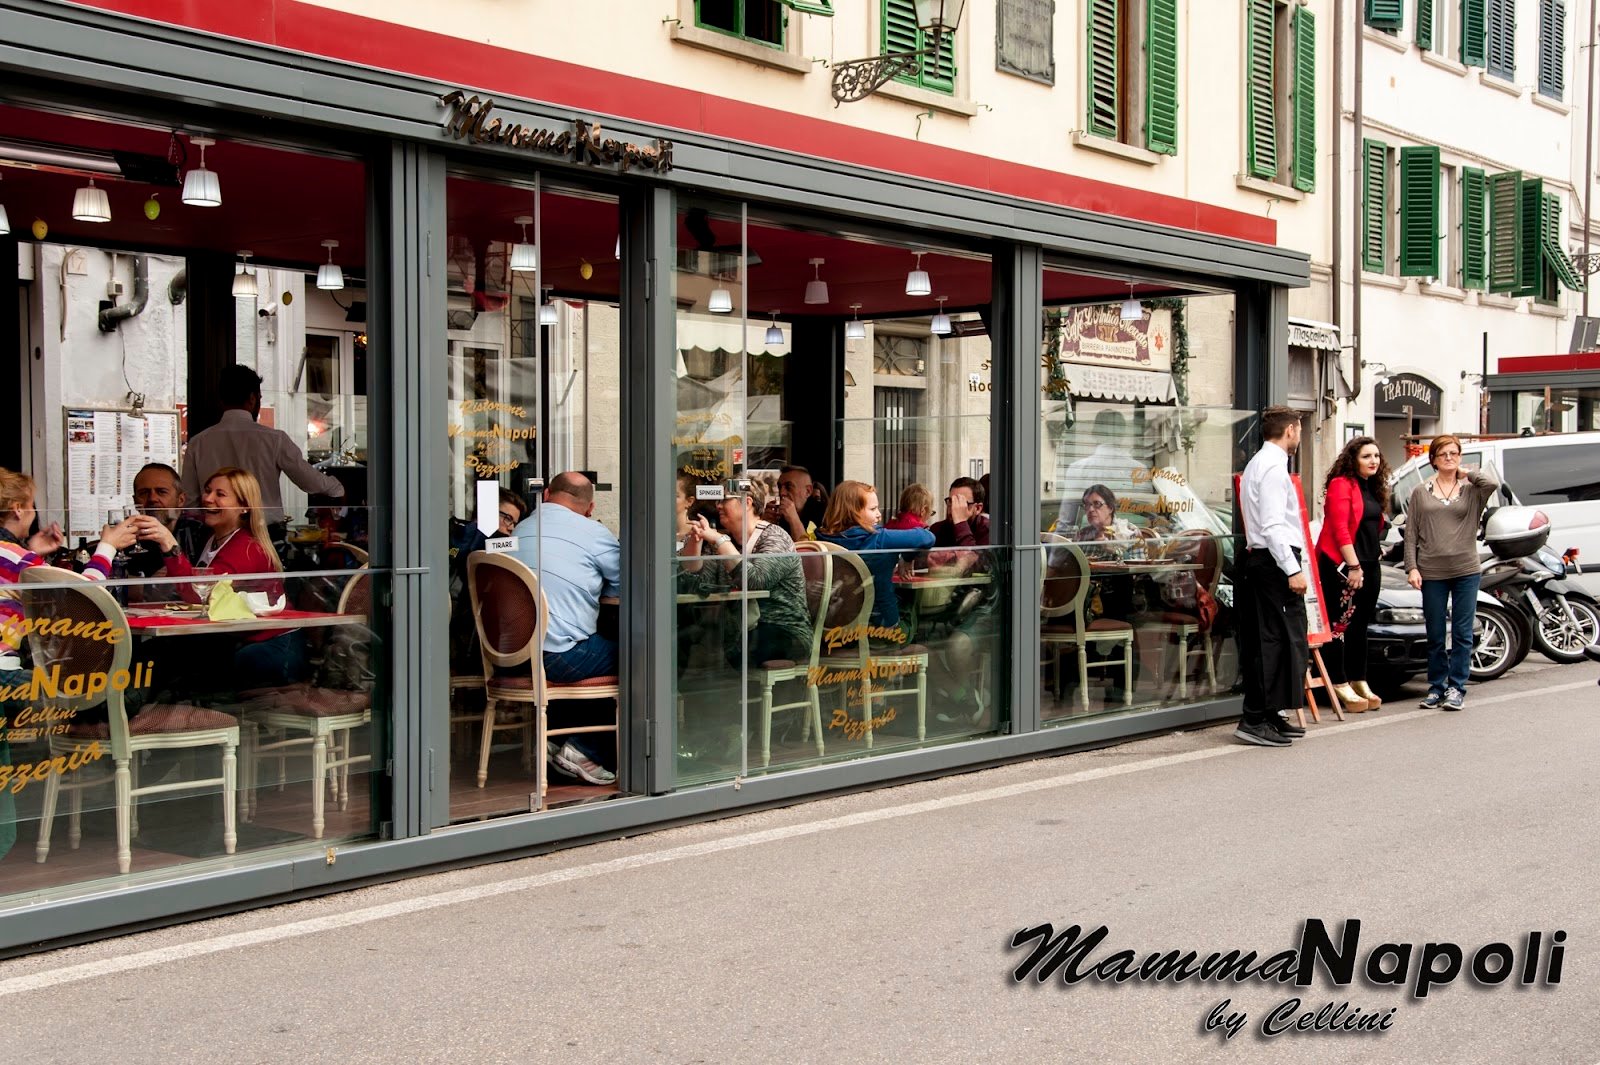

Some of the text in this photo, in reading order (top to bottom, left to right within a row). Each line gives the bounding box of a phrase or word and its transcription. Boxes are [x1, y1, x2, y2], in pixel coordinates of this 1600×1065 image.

[1382, 379, 1432, 405] TRATTORIA
[698, 489, 722, 497] SPINGERE
[491, 540, 513, 550] TIRARE
[0, 614, 126, 645] torante
[825, 623, 907, 655] Ristorante
[14, 706, 79, 728] Cellini
[0, 741, 107, 793] zzeria
